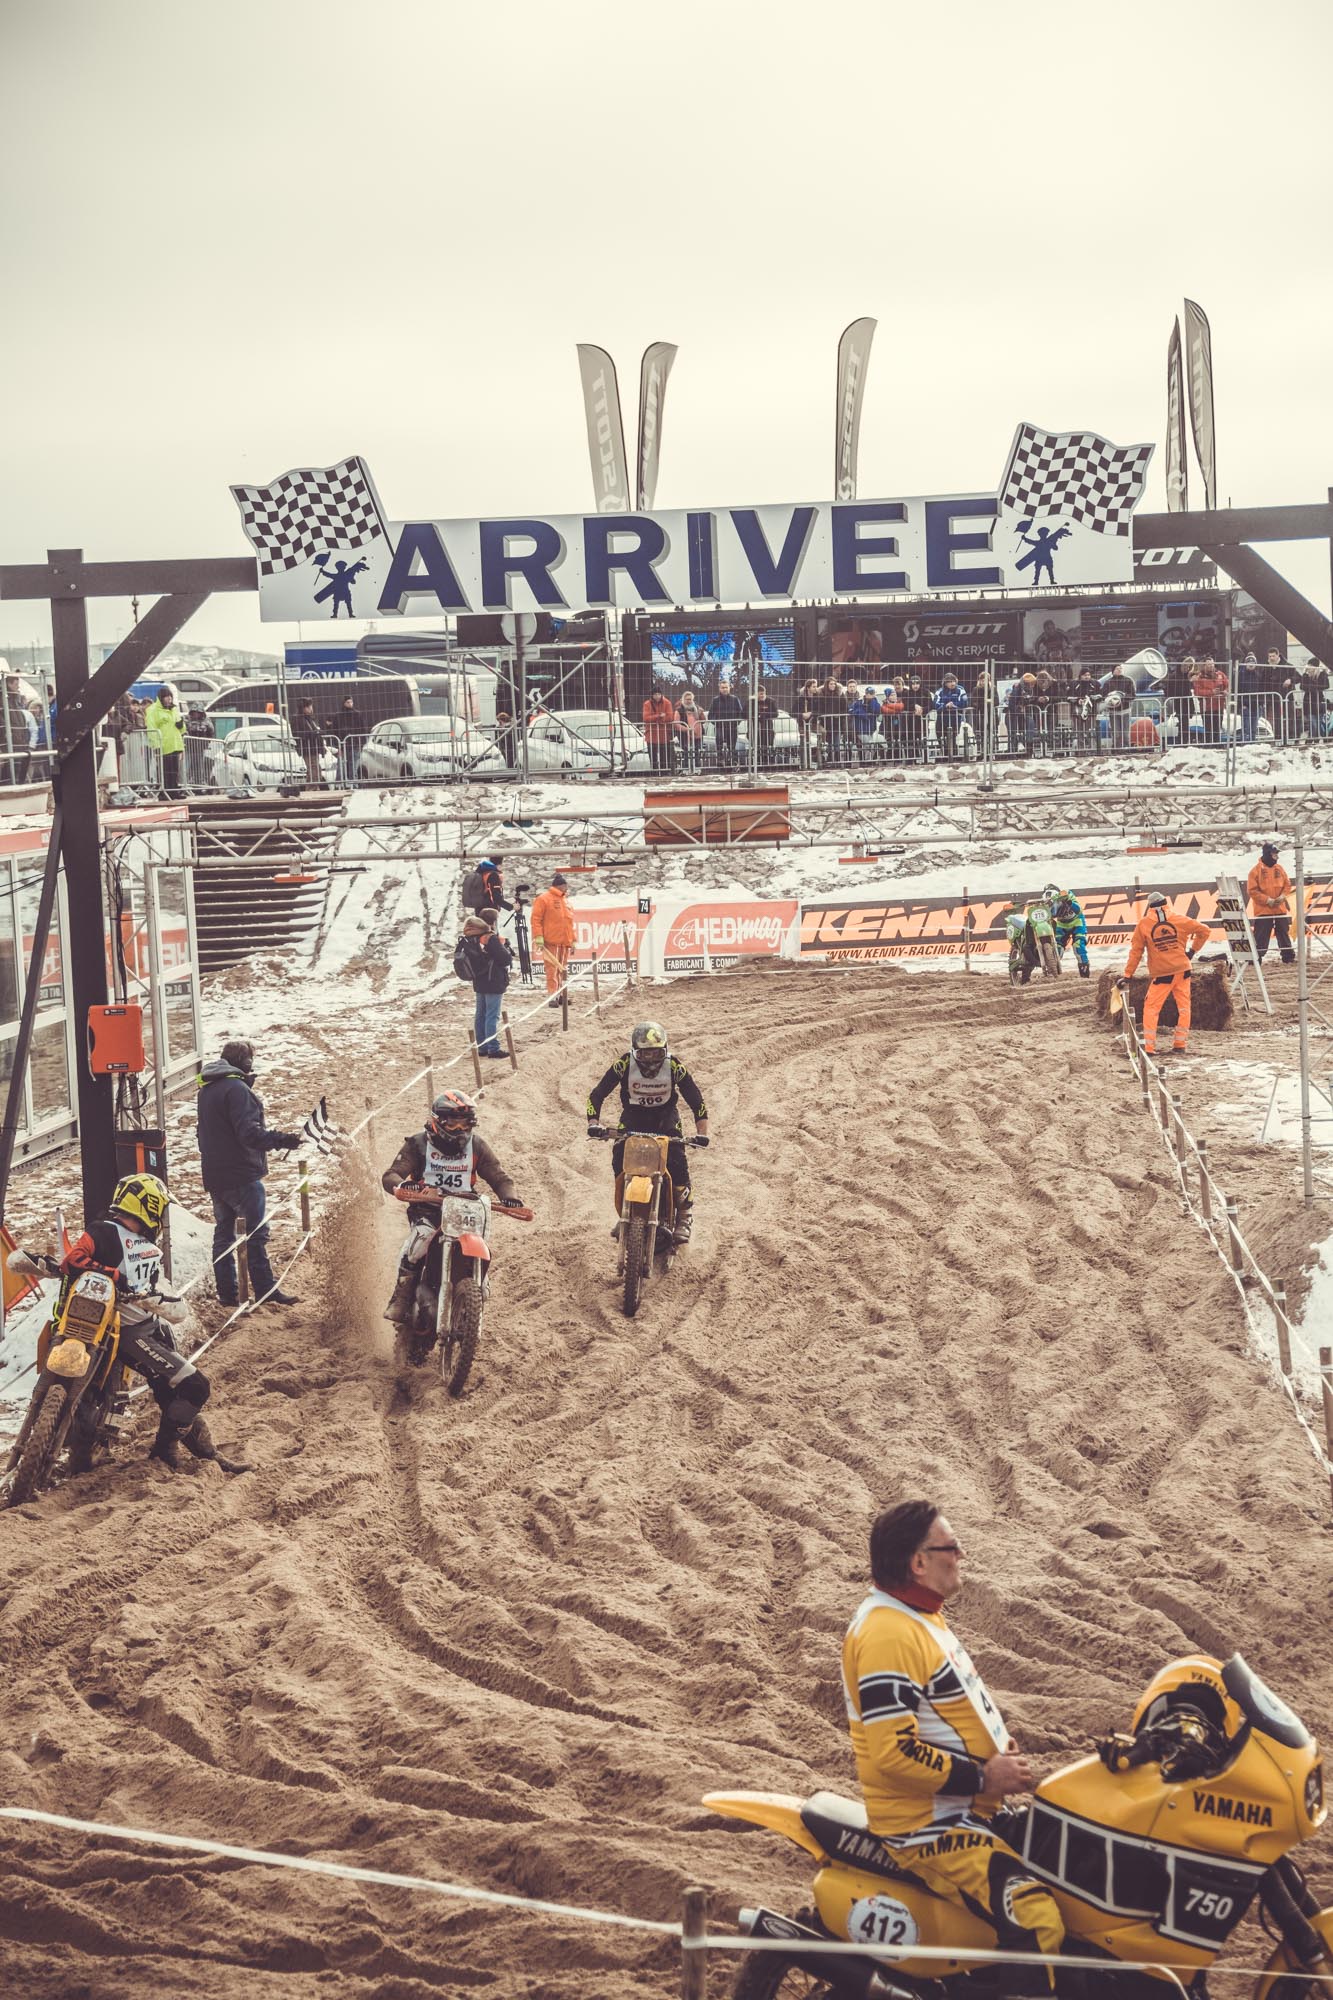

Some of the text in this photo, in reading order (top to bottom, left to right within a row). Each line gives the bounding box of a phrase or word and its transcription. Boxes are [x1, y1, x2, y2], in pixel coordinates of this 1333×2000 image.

[378, 499, 1005, 614] ARRIVEE
[922, 622, 1008, 636] SCOTT
[957, 644, 1006, 656] SERVICE
[640, 901, 649, 913] 74
[801, 901, 1012, 943] KENNY
[667, 959, 704, 969] FABRICANT
[434, 1173, 463, 1188] 345
[136, 1338, 175, 1369] SHIFT
[1193, 1791, 1273, 1827] YAMAHA
[1184, 1888, 1233, 1920] 750
[860, 1911, 907, 1946] 412
